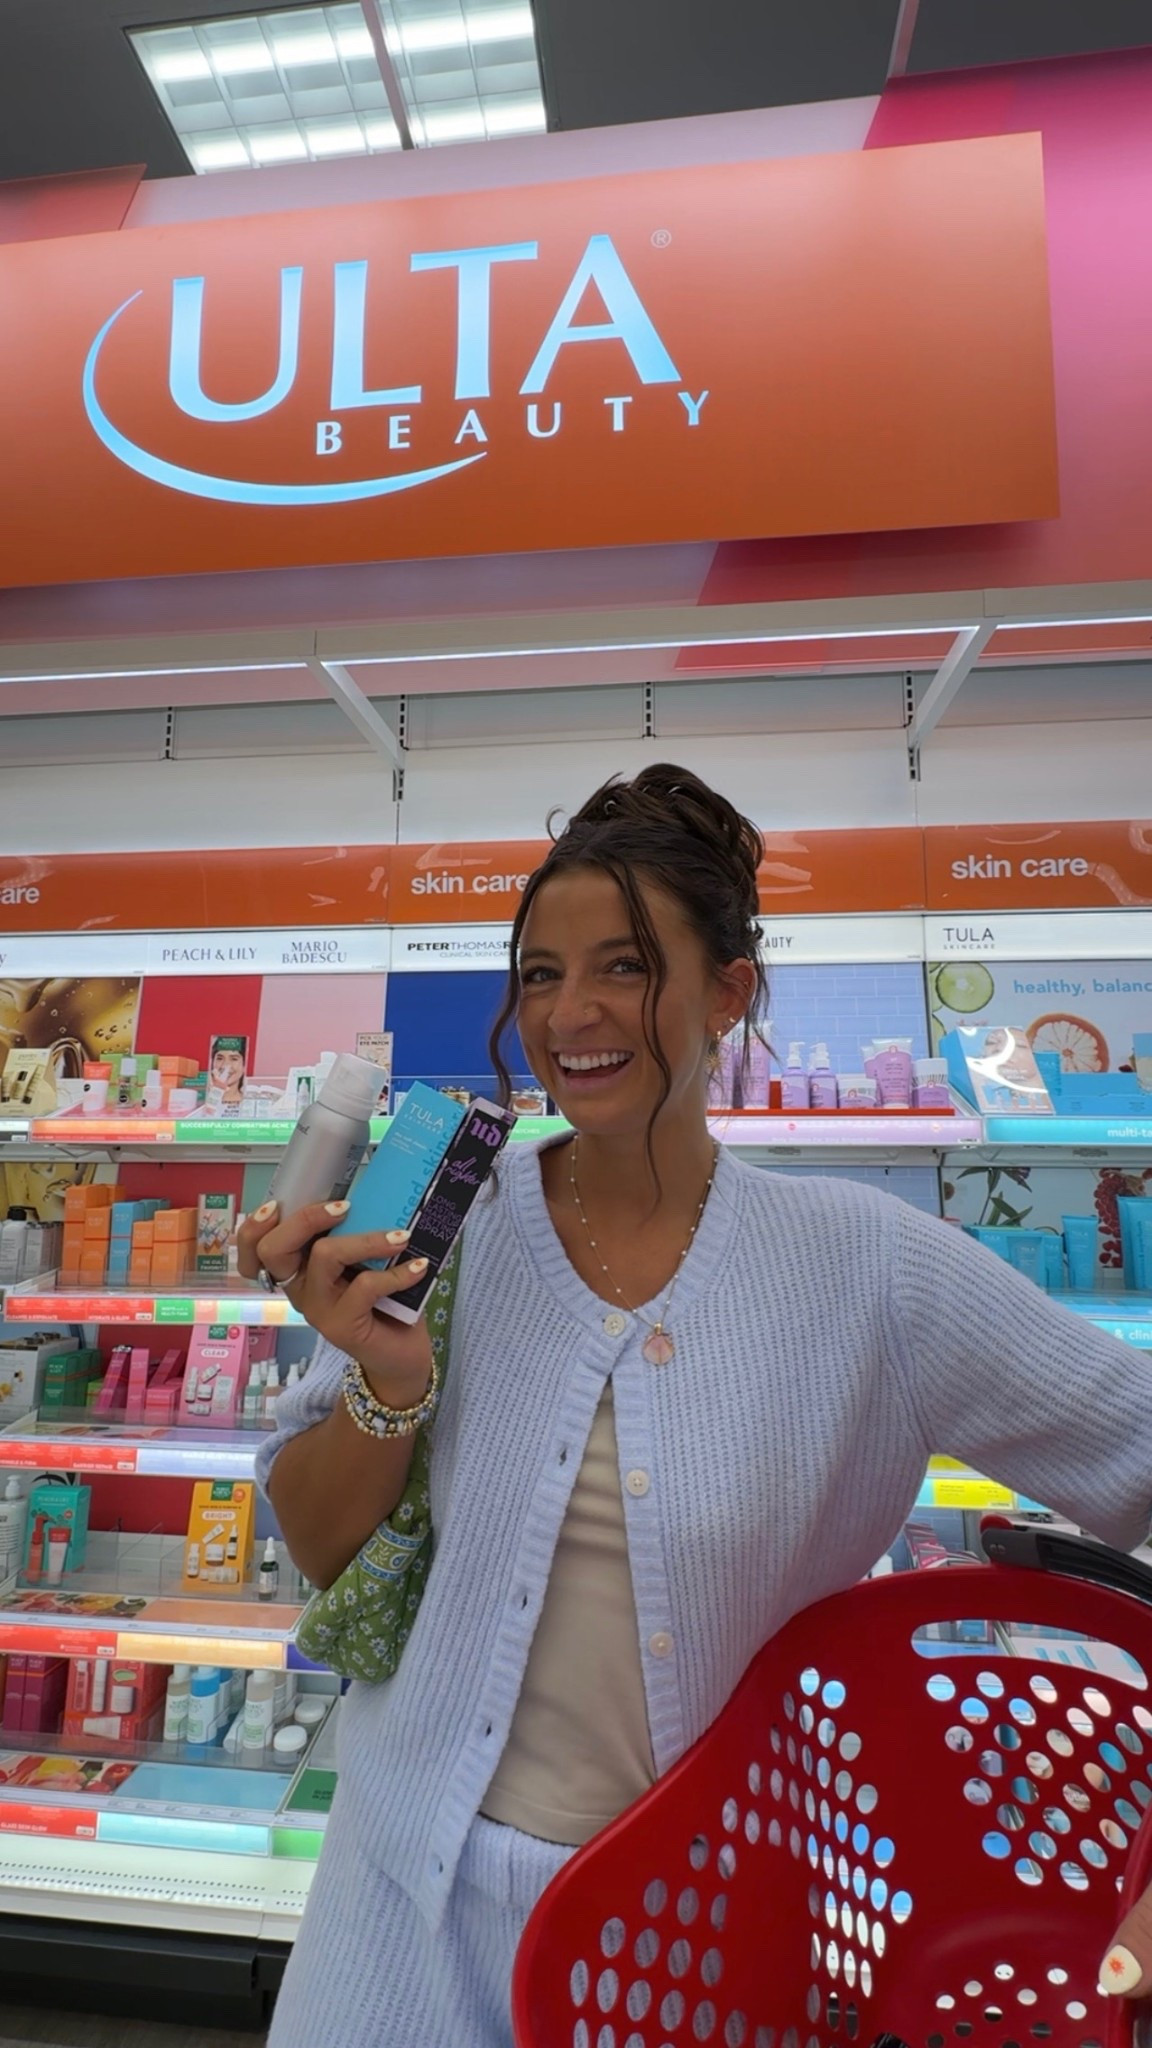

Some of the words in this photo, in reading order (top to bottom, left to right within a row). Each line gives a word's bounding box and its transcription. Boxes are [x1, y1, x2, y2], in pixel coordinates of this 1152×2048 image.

[170, 235, 682, 423] ULTA
[316, 391, 709, 455] BEAUTY
[951, 854, 1011, 880] skin
[1020, 857, 1089, 878] care
[411, 871, 465, 895] skin
[0, 887, 40, 904] are
[764, 935, 793, 949] AUTY
[942, 927, 995, 942] TULA
[162, 948, 211, 961] PEACH
[215, 948, 225, 961] &
[229, 946, 258, 960] LILY
[291, 940, 338, 953] MARIO
[407, 940, 513, 952] PETERTHOMASR
[281, 951, 348, 964] BADESCU
[1013, 978, 1086, 997] healthy,
[410, 1103, 444, 1129] TULA
[395, 1179, 425, 1229] nced
[428, 1201, 462, 1221] LASTING
[431, 1194, 456, 1210] LONG
[417, 1220, 453, 1242] SPRAY
